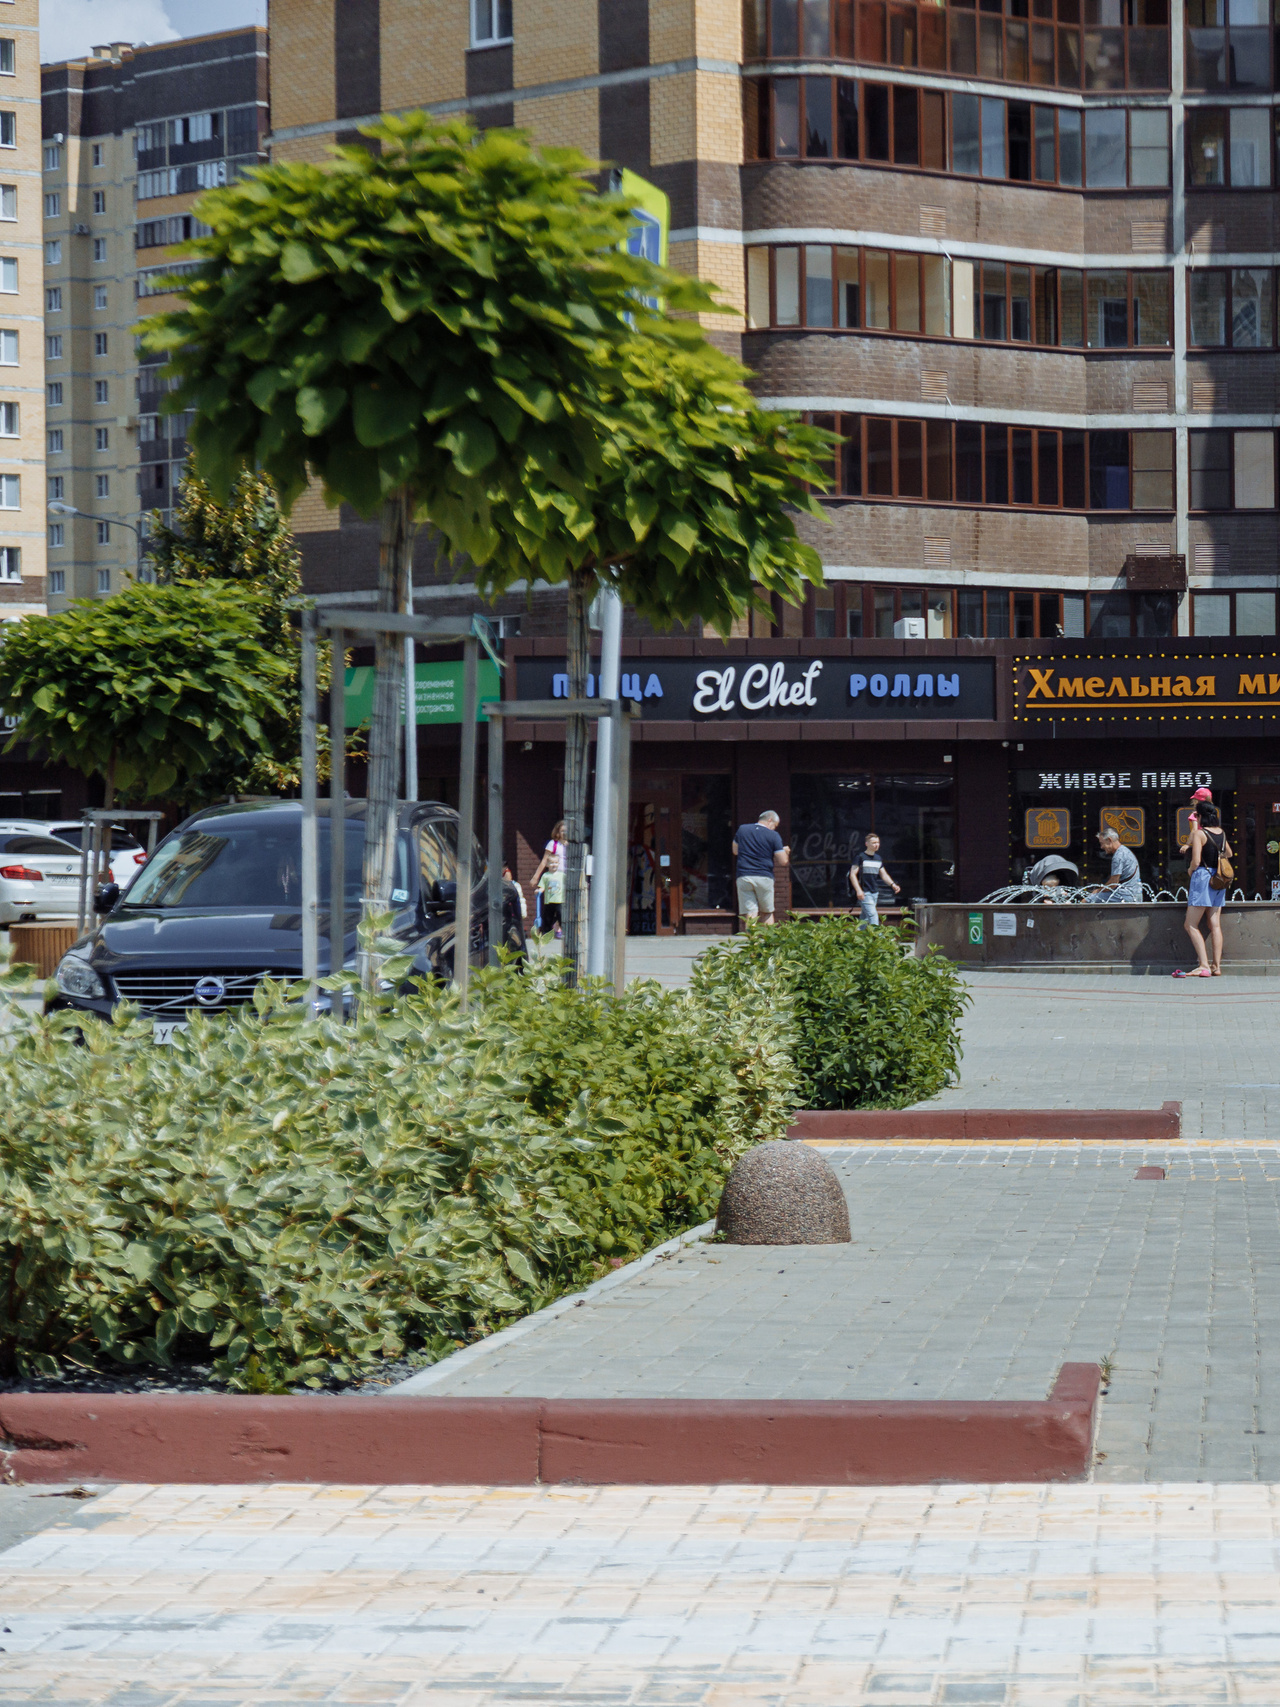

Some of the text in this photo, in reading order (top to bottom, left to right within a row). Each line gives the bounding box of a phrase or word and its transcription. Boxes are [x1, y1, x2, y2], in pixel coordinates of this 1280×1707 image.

[553, 673, 663, 701] ПЦА
[693, 660, 823, 713] El Chef
[850, 673, 960, 698] РОЛЛЫ
[1027, 669, 1216, 699] Хмельная
[1038, 772, 1213, 789] ЖИВОЕ ПИВО
